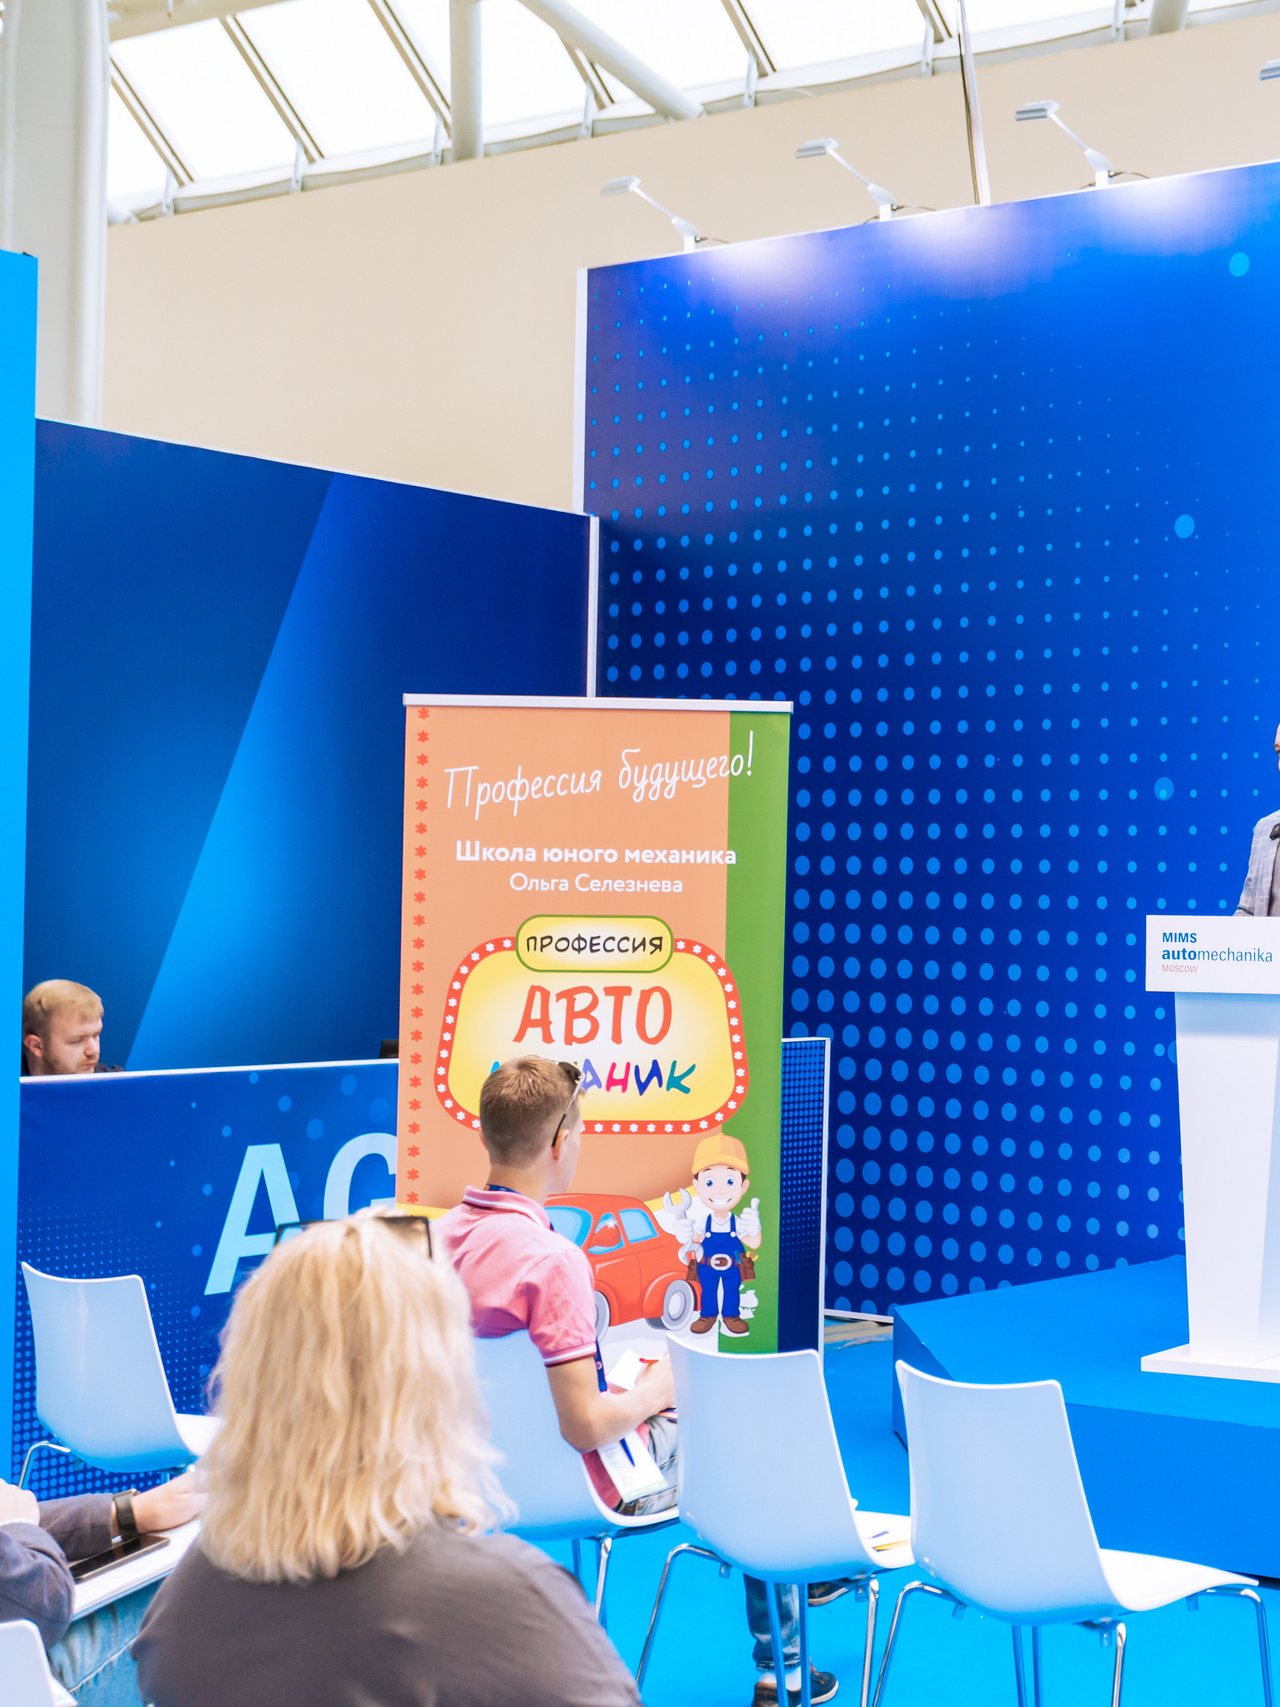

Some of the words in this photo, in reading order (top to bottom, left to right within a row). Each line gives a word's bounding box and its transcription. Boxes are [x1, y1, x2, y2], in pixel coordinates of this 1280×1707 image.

[444, 765, 602, 821] Профессия
[618, 730, 754, 803] будущего!
[455, 840, 536, 863] Школа
[543, 847, 619, 865] юного
[623, 847, 737, 865] механика
[509, 873, 569, 892] Ольга
[574, 874, 683, 893] Селезнева
[526, 934, 664, 956] ПРОФЕССИЯ
[1162, 932, 1197, 943] MIMS
[1161, 947, 1273, 962] automechanika
[1161, 964, 1198, 973] MOSCOW
[512, 984, 673, 1046] АВТО
